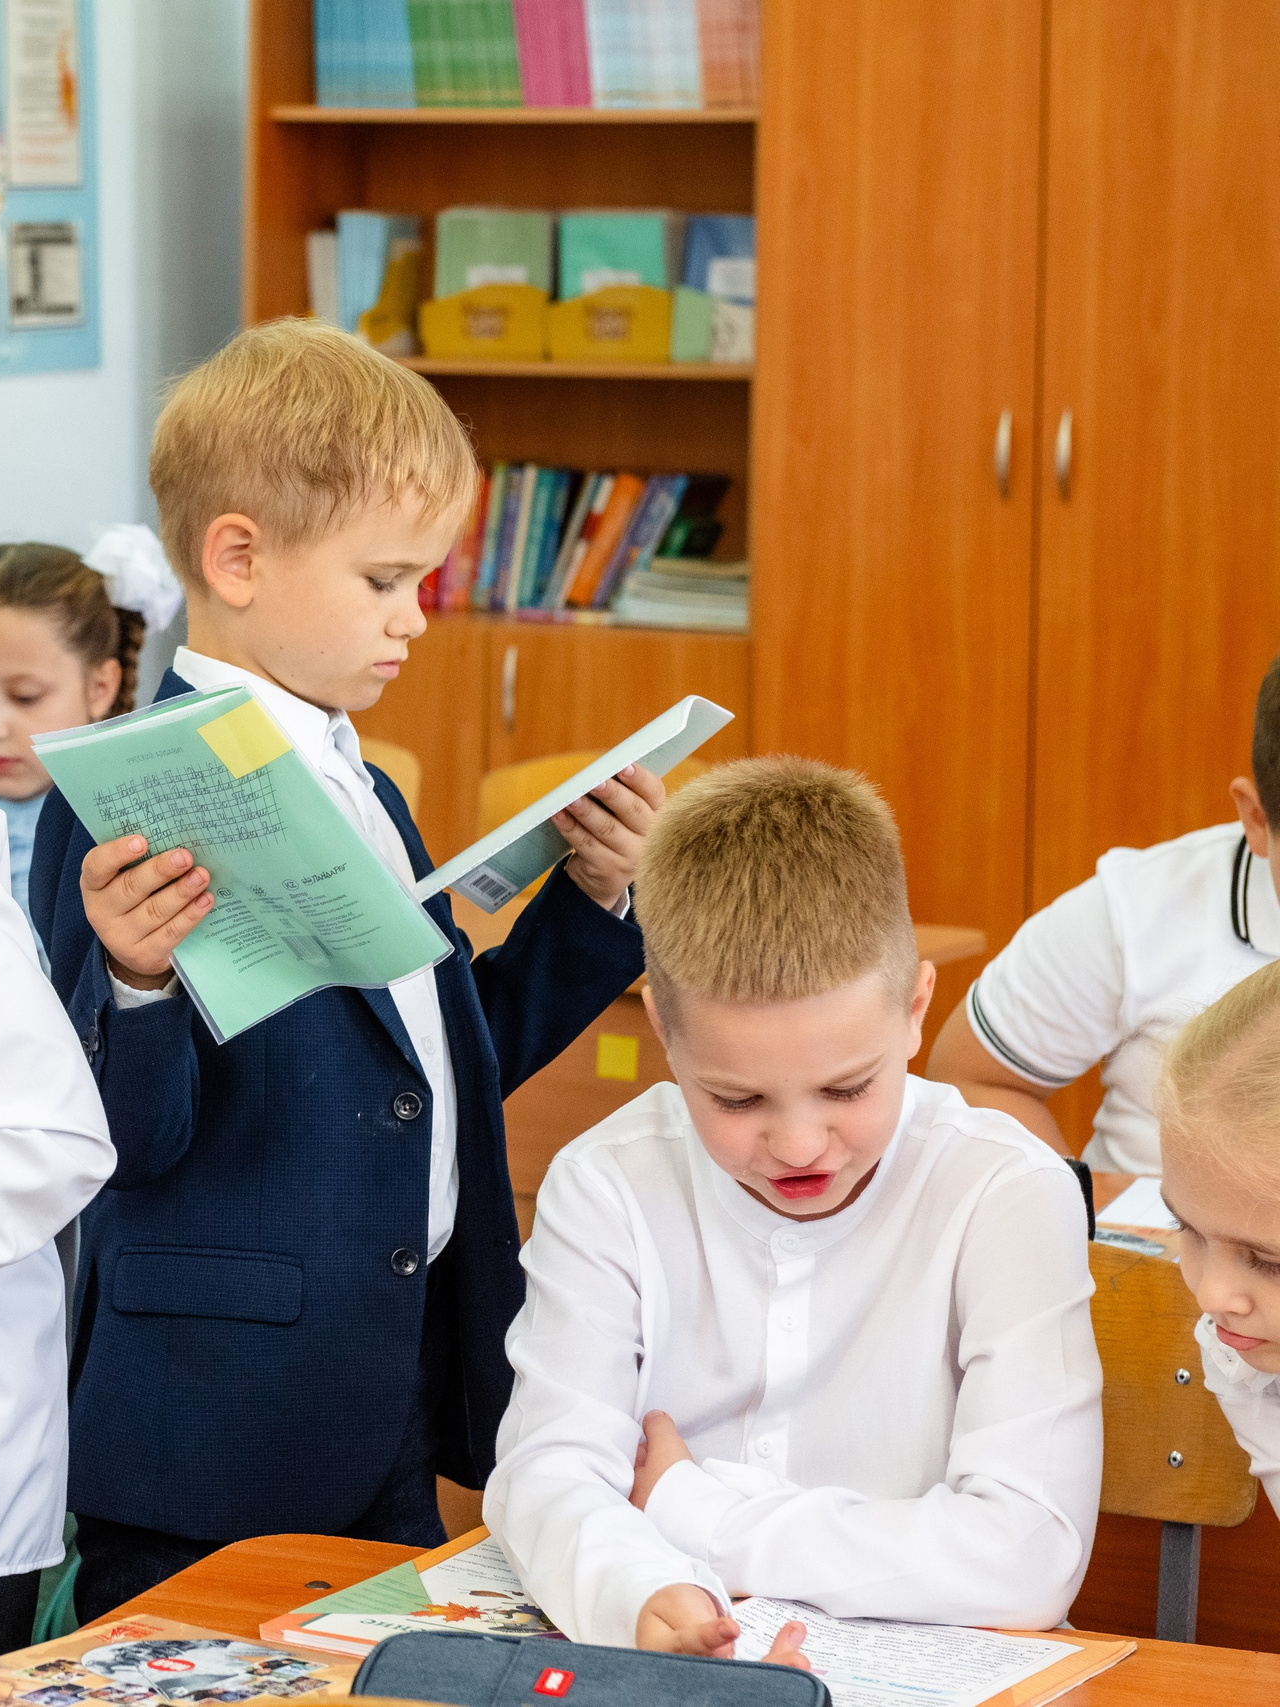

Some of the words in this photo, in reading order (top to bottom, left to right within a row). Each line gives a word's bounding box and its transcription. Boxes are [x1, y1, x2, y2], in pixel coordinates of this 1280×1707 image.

[126, 752, 154, 765] РУССКИЙ
[156, 746, 184, 758] АЛФАВИТ
[219, 889, 231, 897] RU
